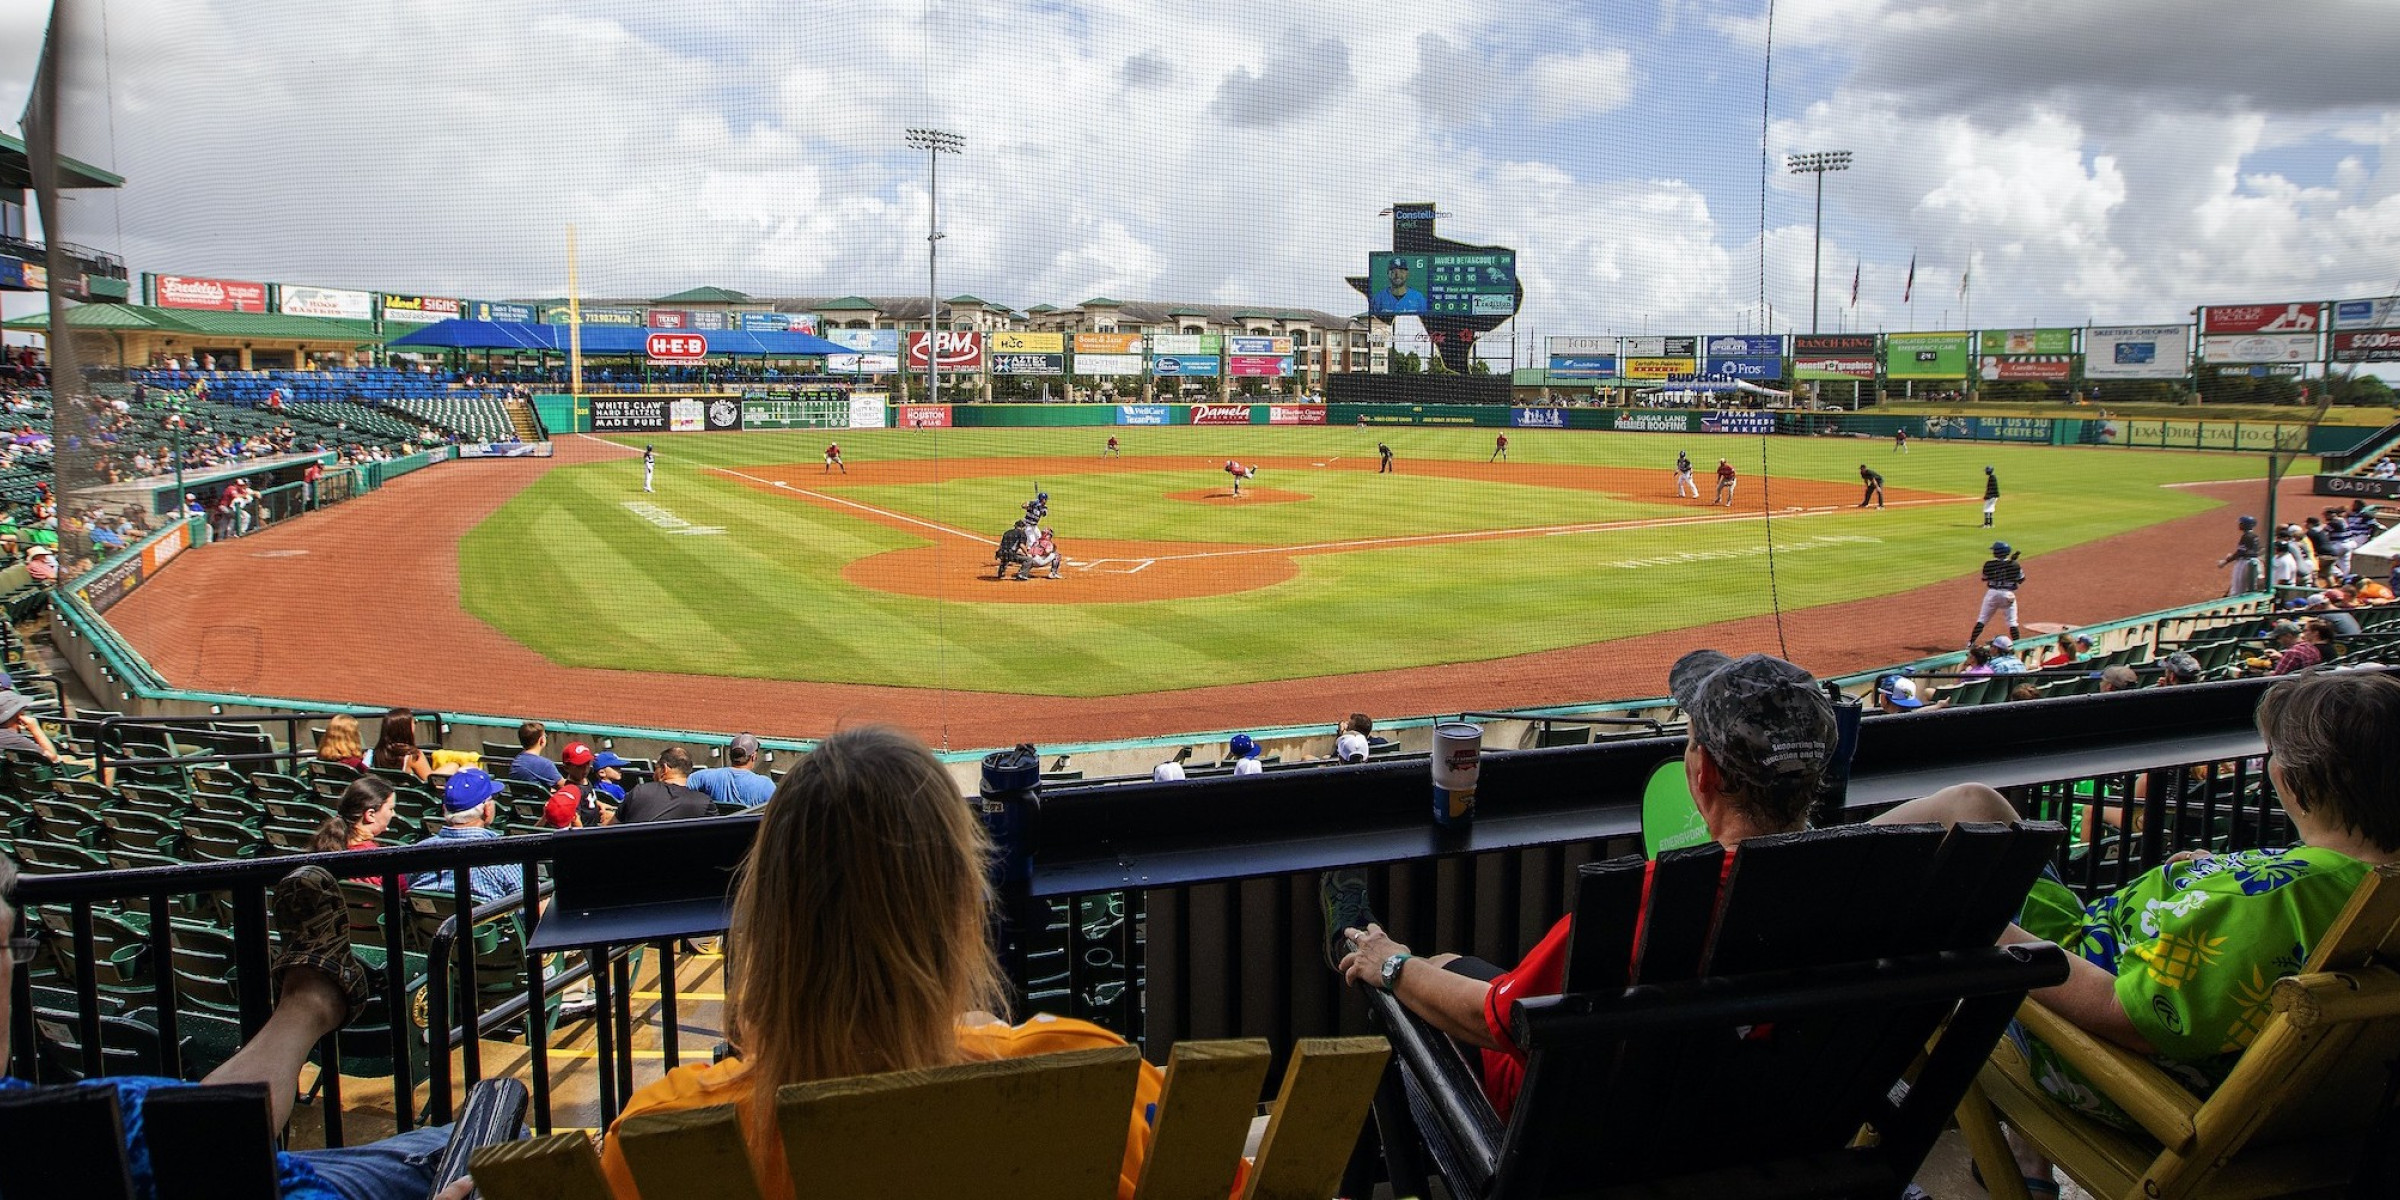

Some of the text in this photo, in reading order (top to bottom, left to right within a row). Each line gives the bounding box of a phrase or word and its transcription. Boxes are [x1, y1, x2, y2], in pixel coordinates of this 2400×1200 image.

[1396, 210, 1453, 219] Constellation
[1396, 220, 1417, 229] Field
[1416, 259, 1424, 268] 6
[385, 295, 421, 310] Ideal
[2094, 327, 2180, 337] SKEETERS CHECKING
[1011, 355, 1047, 365] AZTEC
[595, 401, 662, 410] WHITE CLAW
[907, 411, 945, 420] HOUSTON
[1633, 414, 1688, 422] SUGAR LAND
[595, 418, 662, 427] MADE PURE
[1614, 421, 1688, 431] PREMIER ROOFING
